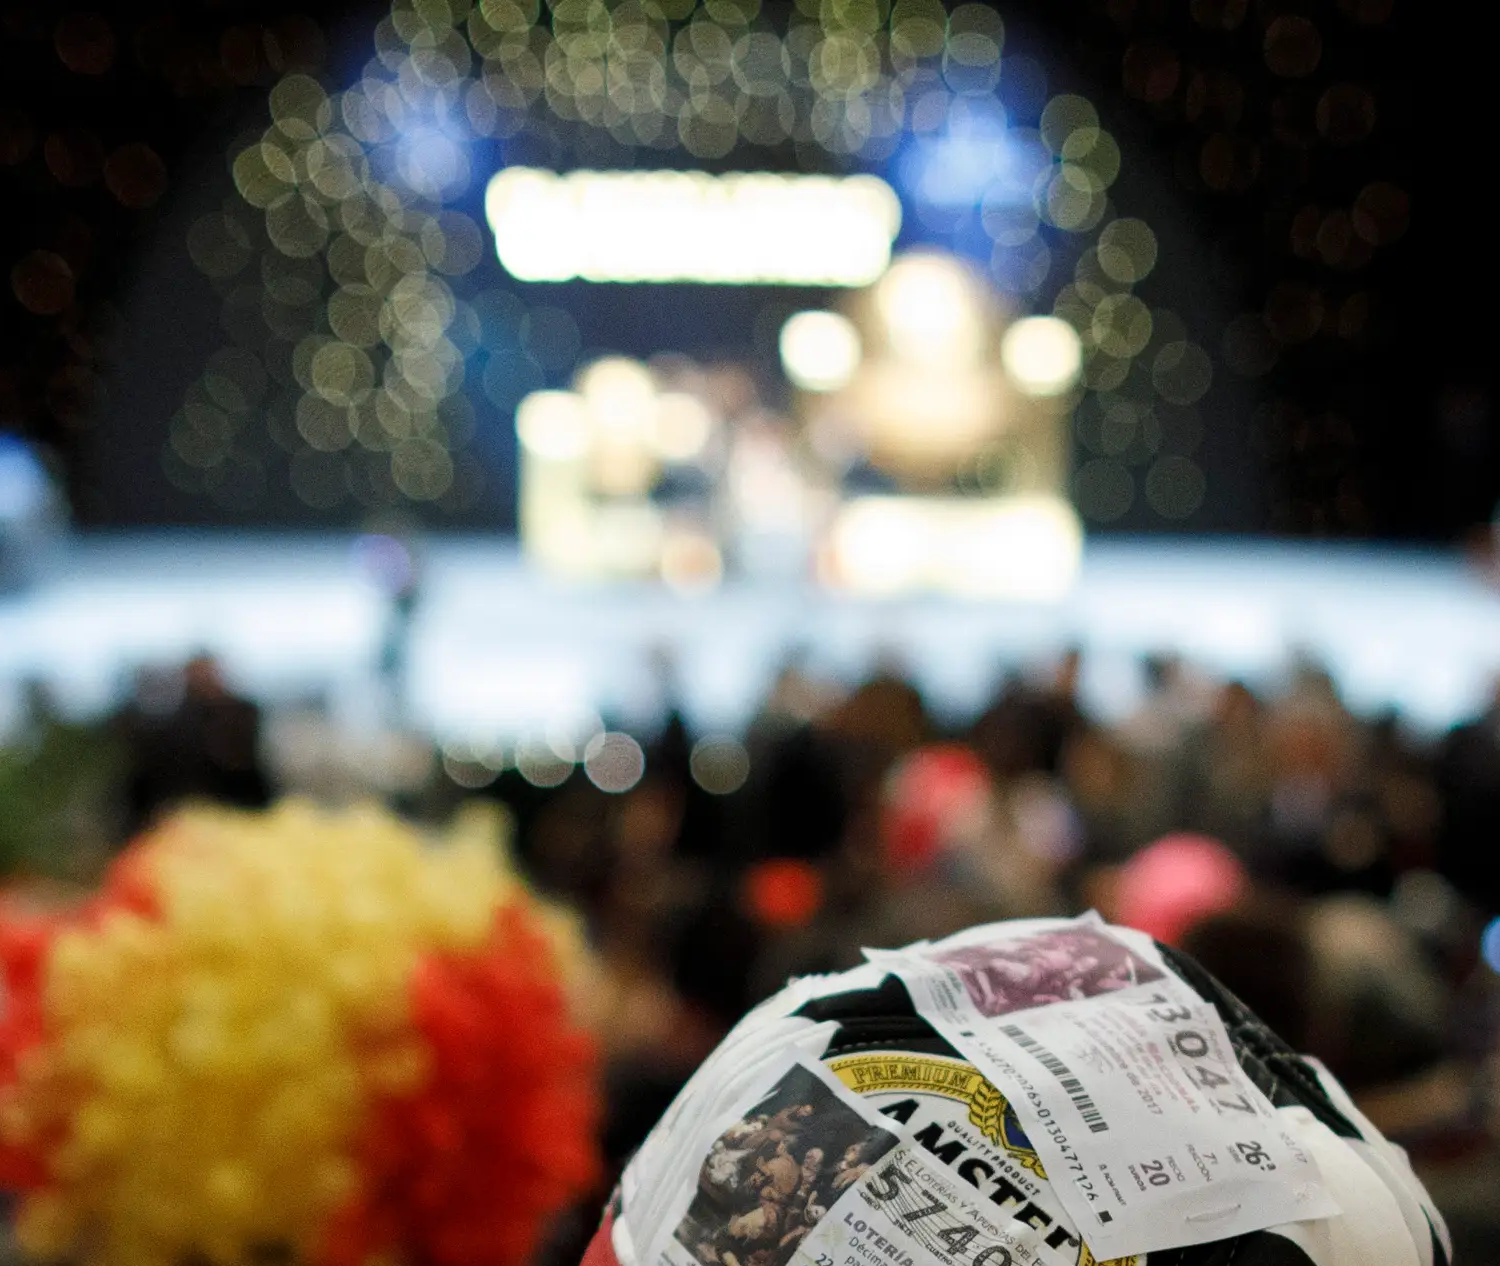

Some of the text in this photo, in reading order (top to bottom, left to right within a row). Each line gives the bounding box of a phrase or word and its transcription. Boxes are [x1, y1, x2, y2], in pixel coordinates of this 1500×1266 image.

[851, 1063, 973, 1090] PREMIUM
[947, 1120, 1041, 1197] QUALITY PRODUCT
[1140, 1159, 1171, 1187] 20
[925, 1242, 953, 1265] CUATRO
[1016, 1243, 1032, 1261] DEL
